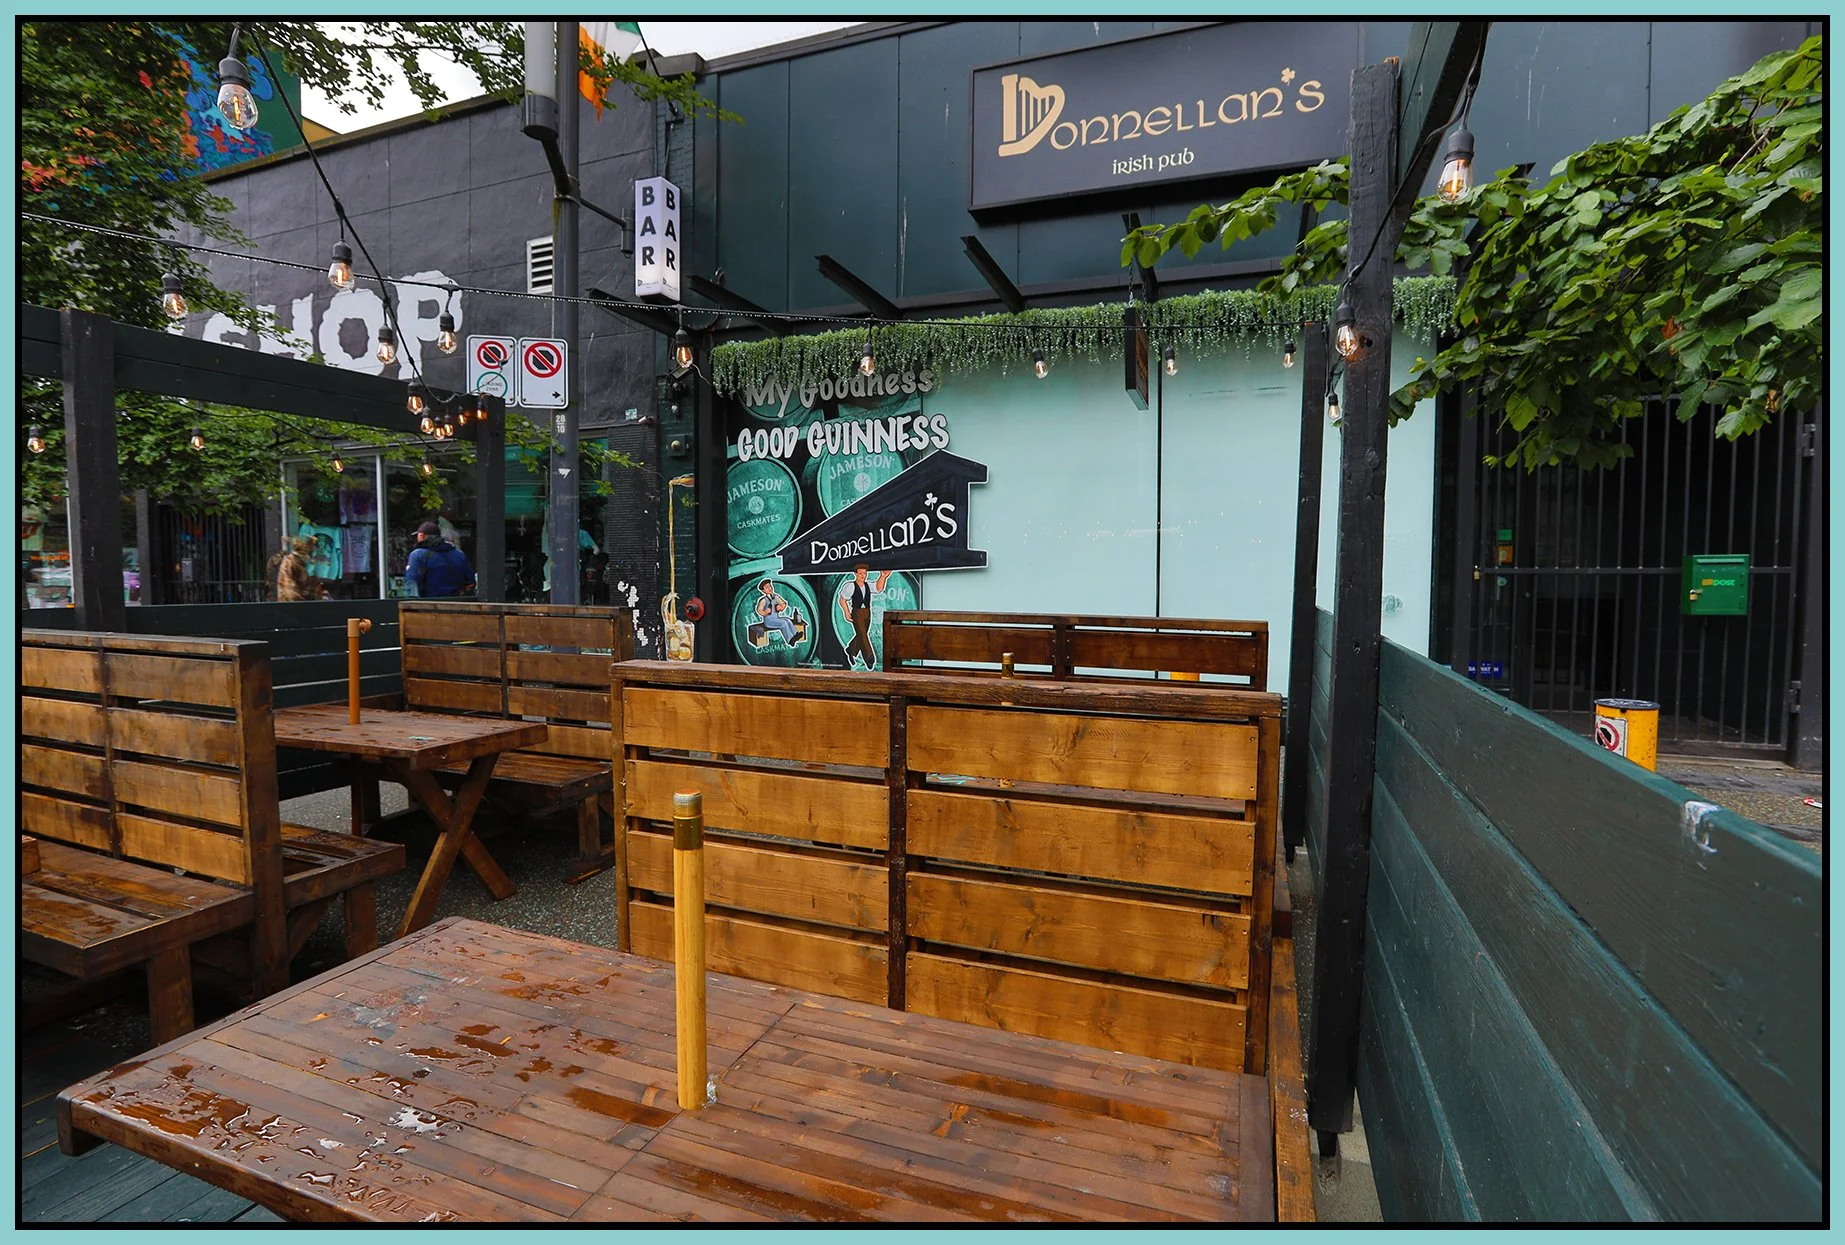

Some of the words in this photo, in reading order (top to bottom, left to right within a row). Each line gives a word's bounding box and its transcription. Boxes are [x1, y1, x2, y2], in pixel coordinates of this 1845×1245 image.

[1158, 147, 1195, 172] pub
[640, 185, 657, 266] BAR
[665, 188, 677, 271] BAR
[736, 425, 800, 463] GOOD
[806, 414, 950, 459] GUINNESS
[829, 455, 893, 480] JAMESON
[727, 478, 784, 504] JAMESON
[736, 513, 782, 530] CASKMATES
